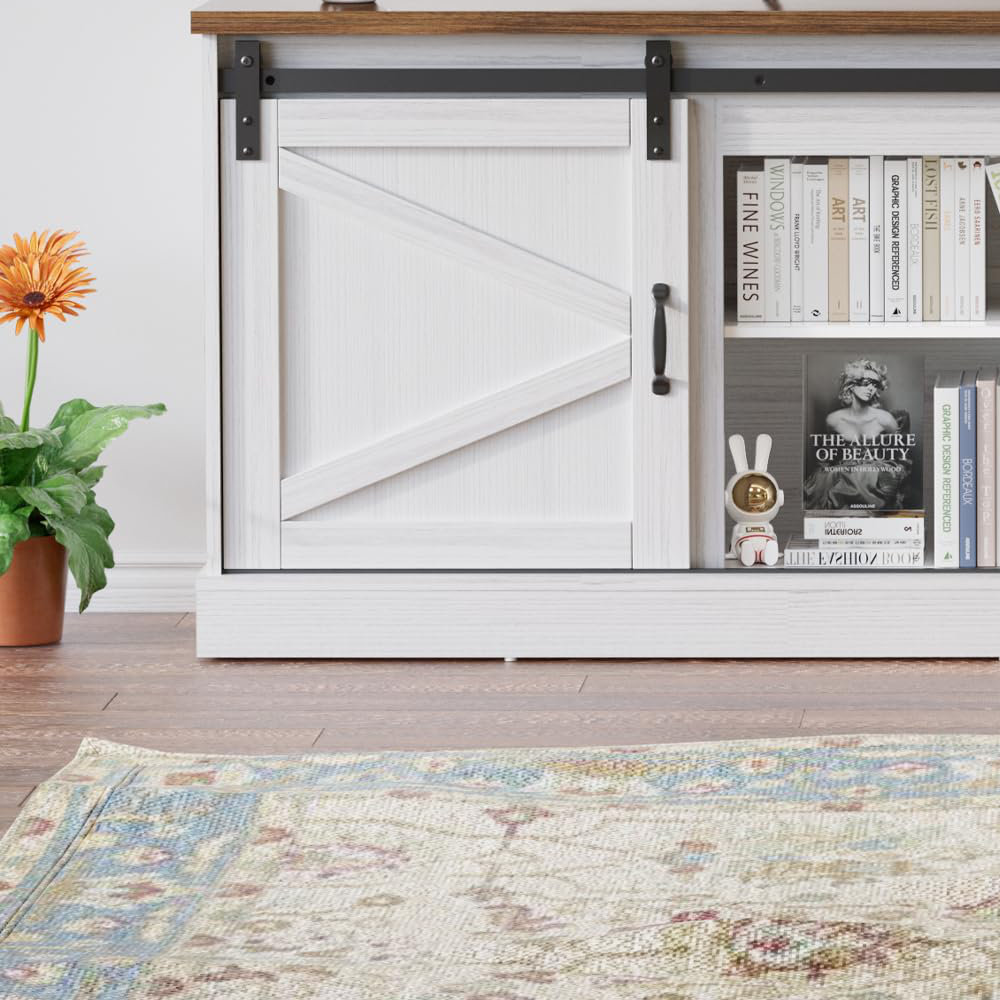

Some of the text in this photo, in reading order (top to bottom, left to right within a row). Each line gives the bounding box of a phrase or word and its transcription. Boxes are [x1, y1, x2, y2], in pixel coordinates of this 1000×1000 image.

[769, 164, 785, 231] WINDOWS
[832, 197, 846, 223] ART
[853, 197, 866, 222] ART
[891, 174, 900, 209] GRAPHIC
[925, 160, 938, 230] LOST FISH
[742, 192, 759, 233] FINE
[891, 211, 900, 239] DESIGN
[742, 241, 759, 302] WINES
[891, 241, 900, 291] REFERENCED
[810, 433, 916, 447] THE ALLURE
[815, 447, 910, 461] OF BEAUTY
[942, 404, 951, 533] GRAPHIC DESIGN REFERENCED
[962, 458, 973, 505] BORDEAUX
